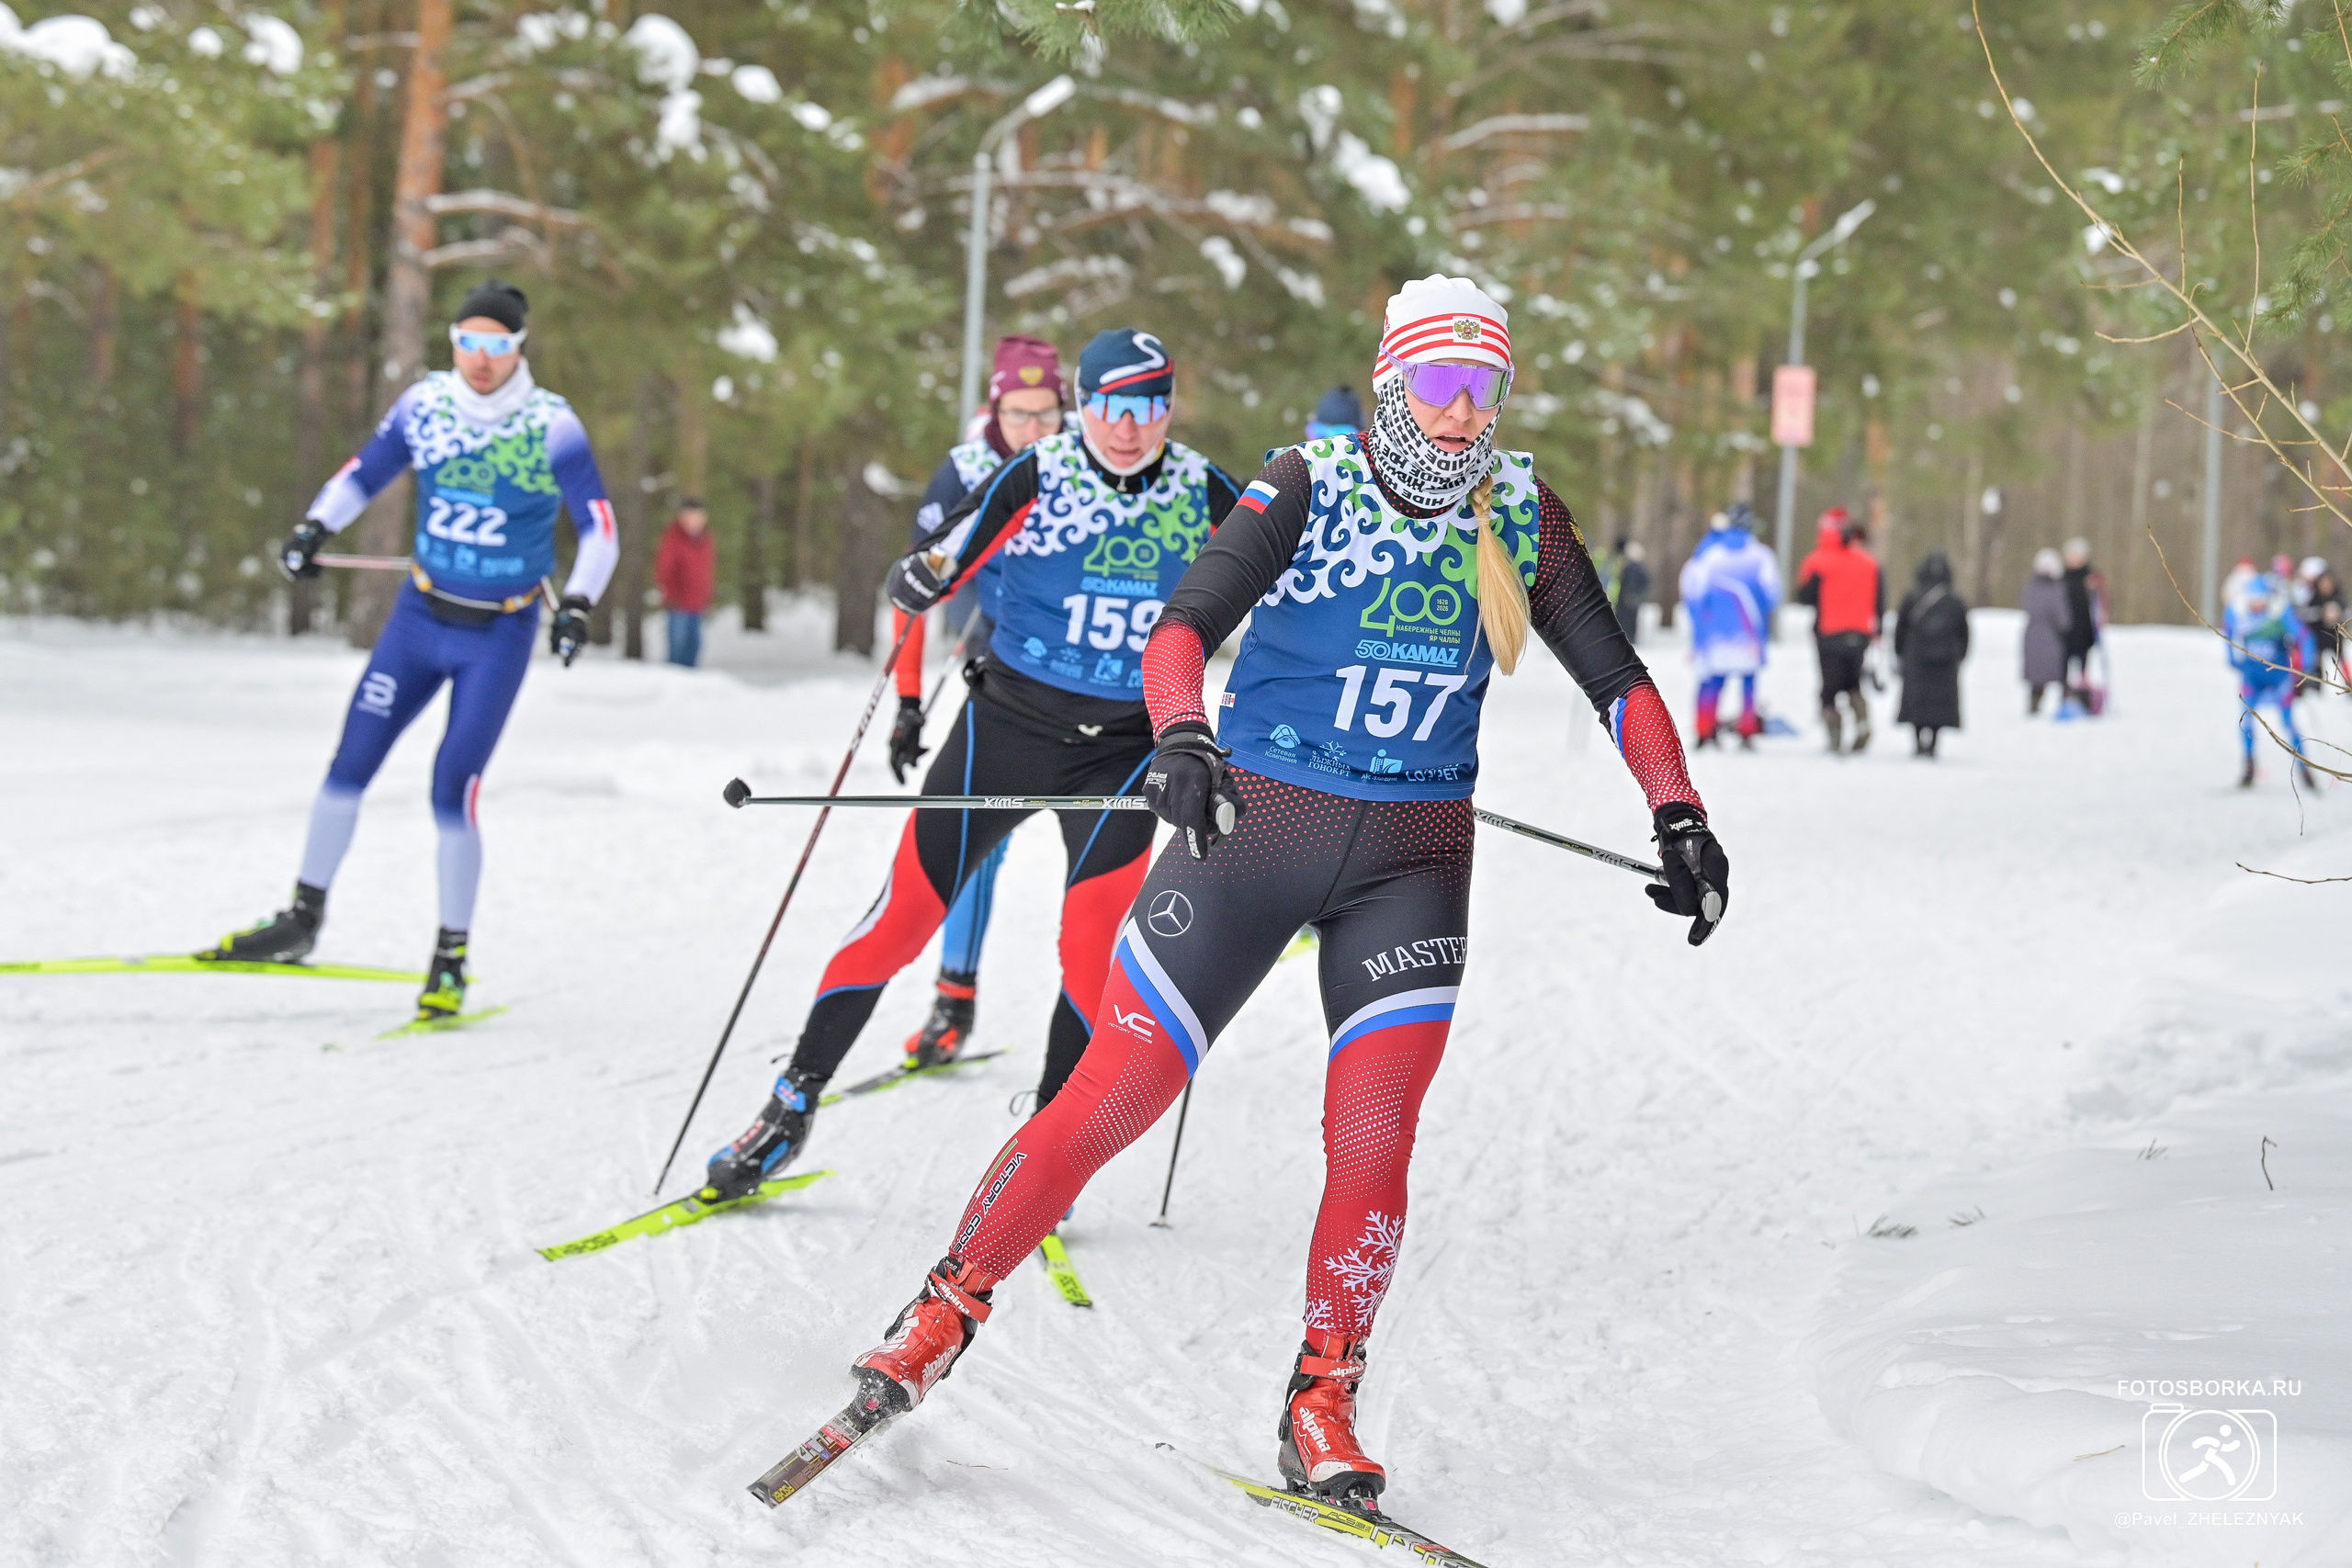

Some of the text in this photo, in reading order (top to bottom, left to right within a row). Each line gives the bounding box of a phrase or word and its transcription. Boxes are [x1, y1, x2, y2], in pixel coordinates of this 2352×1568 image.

[1424, 449, 1471, 472] HIDE
[1402, 488, 1445, 507] HIDE
[426, 496, 508, 547] 222
[1082, 534, 1160, 578] 400
[1063, 593, 1166, 653] 159
[1360, 578, 1462, 637] 400
[1396, 625, 1461, 637] НАБЕРЕЖНЫЕ ЧЕЛНЫ
[1439, 636, 1461, 644] ЧАЛЛЫ
[1334, 664, 1469, 741] 157
[1264, 750, 1297, 764] Компания
[1269, 746, 1296, 758] Сетевая
[1114, 1003, 1156, 1037] VC
[1133, 1032, 1153, 1044] CODE
[953, 1152, 1029, 1253] VICTORY CODE
[938, 1281, 970, 1315] alpina
[922, 1344, 956, 1382] alpina
[1328, 1365, 1364, 1378] alpina
[1299, 1406, 1331, 1453] alpina
[1270, 1495, 1319, 1524] FISCHER
